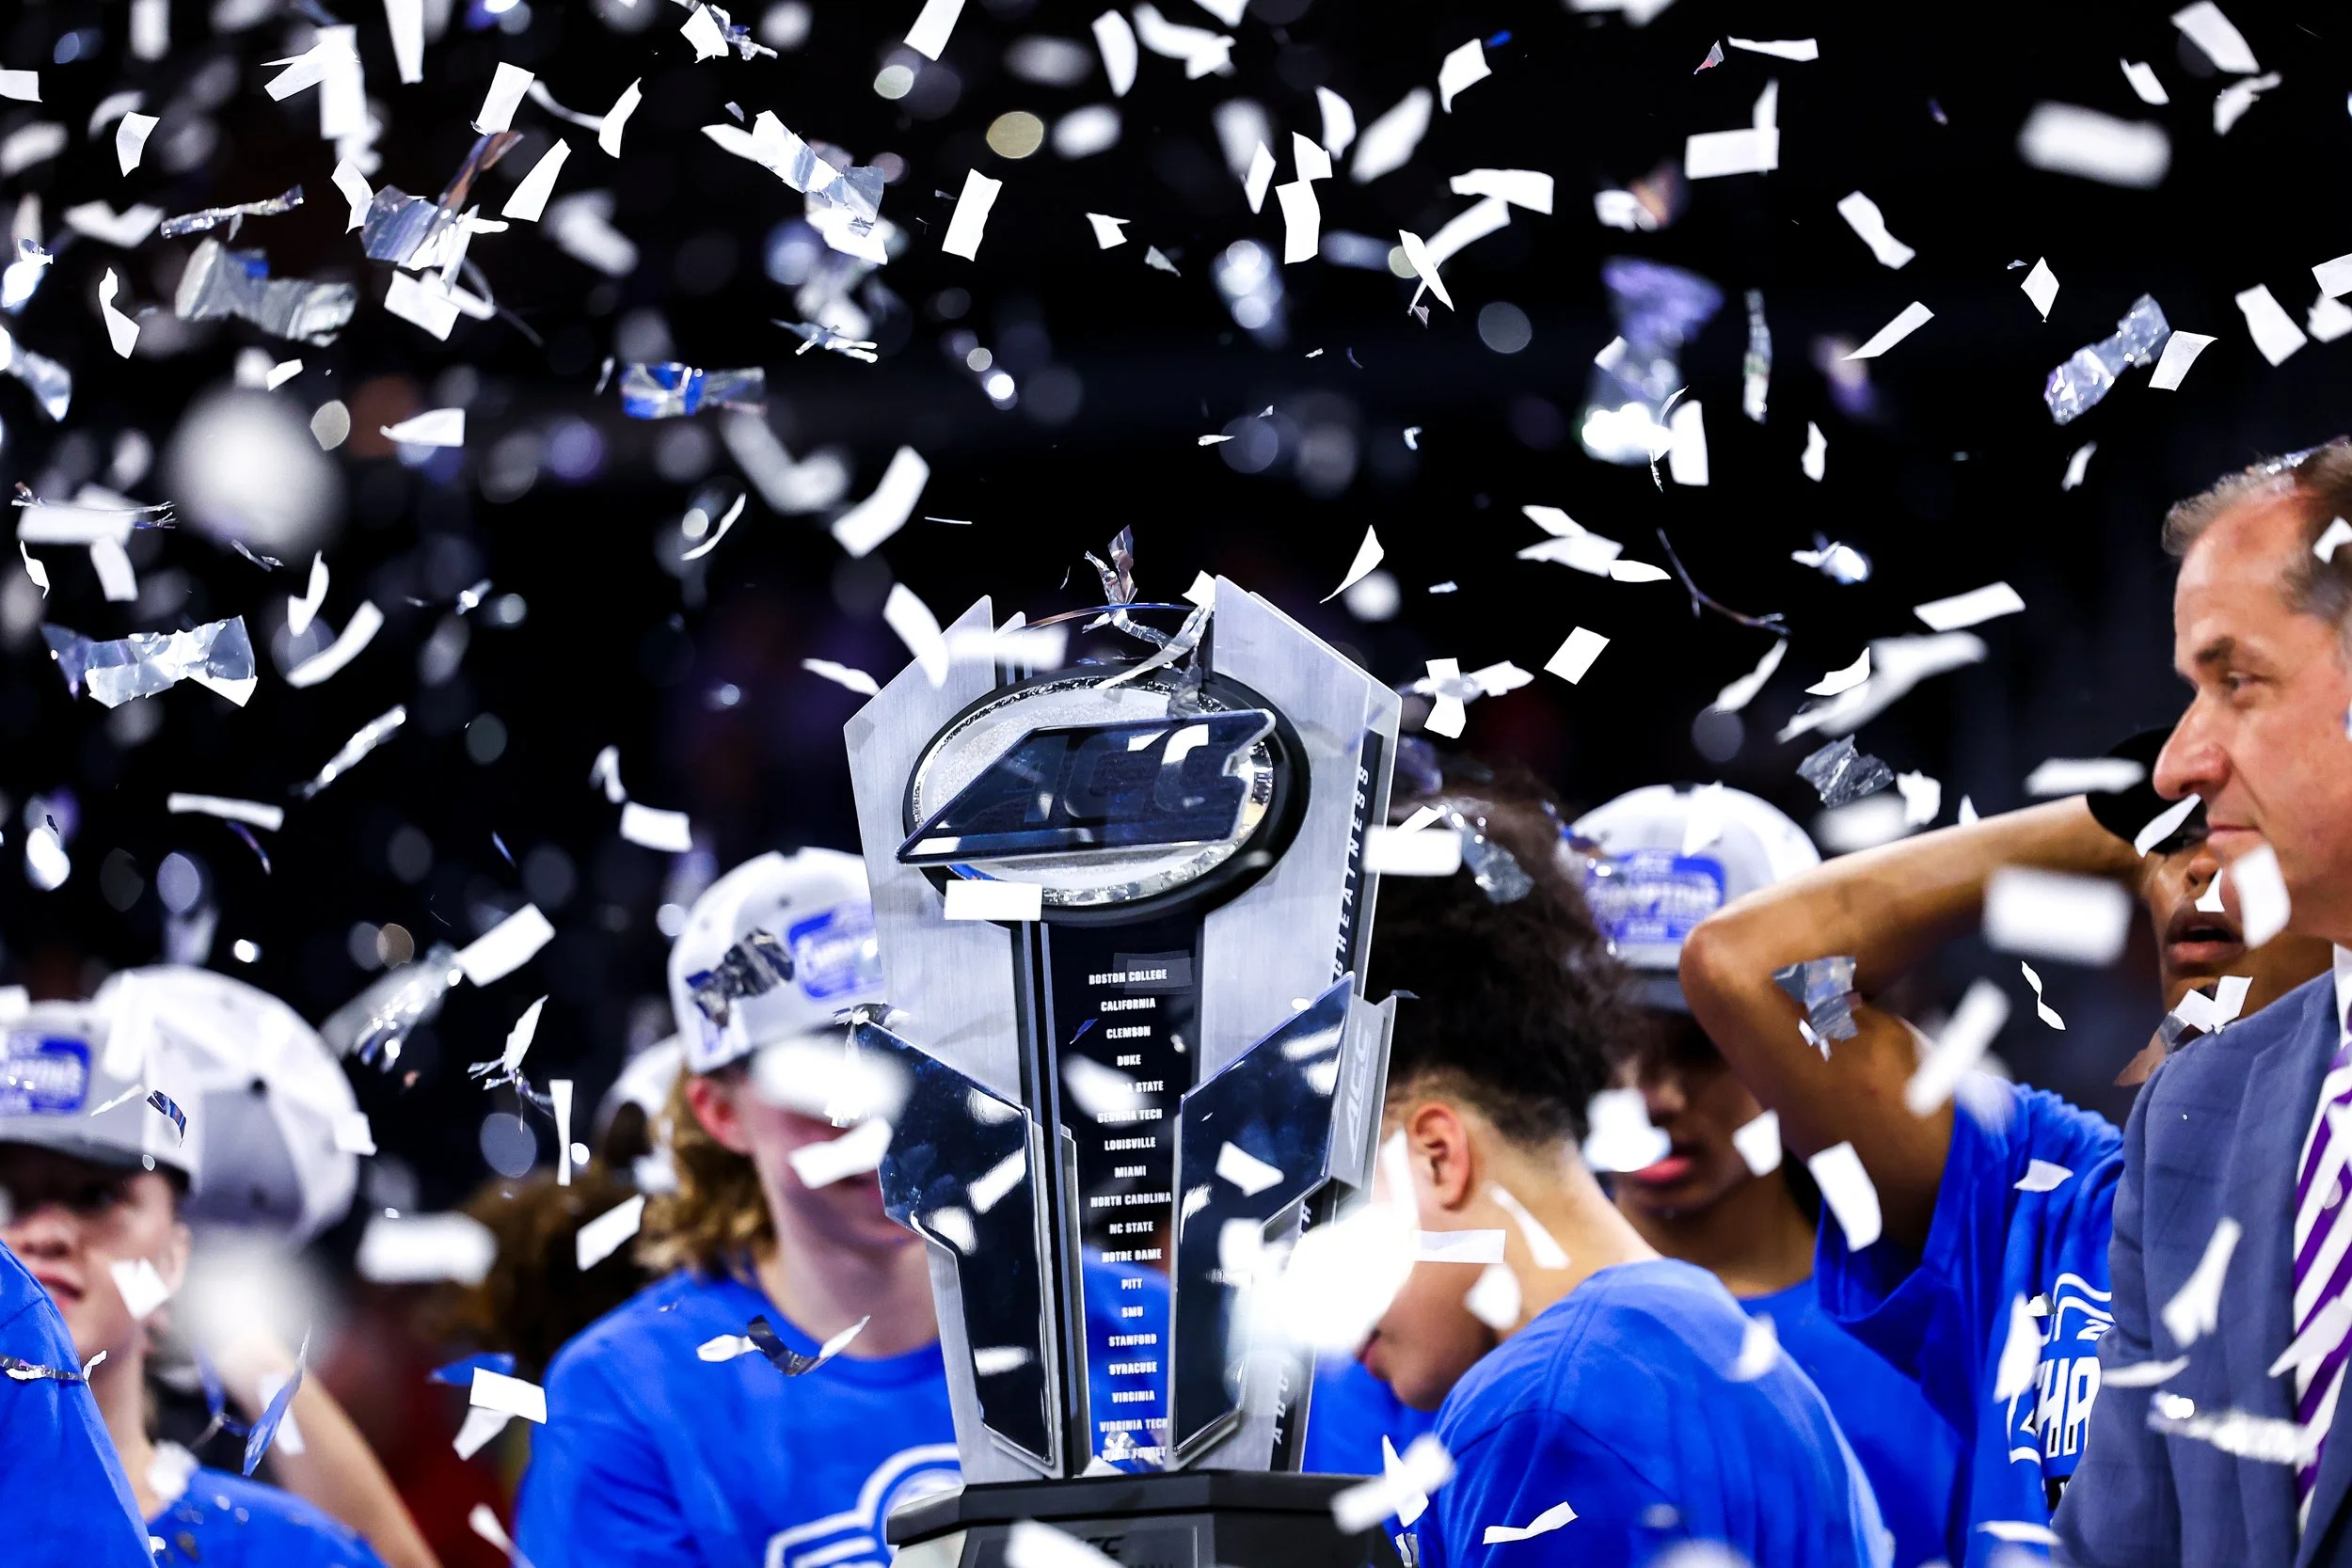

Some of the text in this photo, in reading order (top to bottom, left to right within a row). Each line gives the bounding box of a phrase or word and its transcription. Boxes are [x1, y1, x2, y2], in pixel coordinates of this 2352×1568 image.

[1333, 766, 1369, 979] GREATNESS
[1089, 969, 1168, 985] BOSTON COLLEGE
[1101, 997, 1156, 1011] CALIFORNIA
[1106, 1025, 1151, 1038] CLEMSON
[1117, 1054, 1141, 1066] DUKE
[1136, 1080, 1164, 1093] STATE
[1139, 1108, 1163, 1120] TECH
[1104, 1136, 1156, 1150] LOUISVILLE
[1114, 1165, 1147, 1178] MIAMI
[1089, 1192, 1171, 1208] NORTH CAROLINA
[1109, 1221, 1153, 1234] NC STATE
[1102, 1248, 1162, 1263] NOTRE DAME
[1121, 1277, 1143, 1290] PITT
[1121, 1306, 1143, 1318] SMU
[1108, 1333, 1157, 1347] STANFORD
[1108, 1361, 1157, 1375] SYRACUSE
[1111, 1390, 1155, 1403] VIRGINIA
[1099, 1418, 1168, 1433] VIRGINIA TECH
